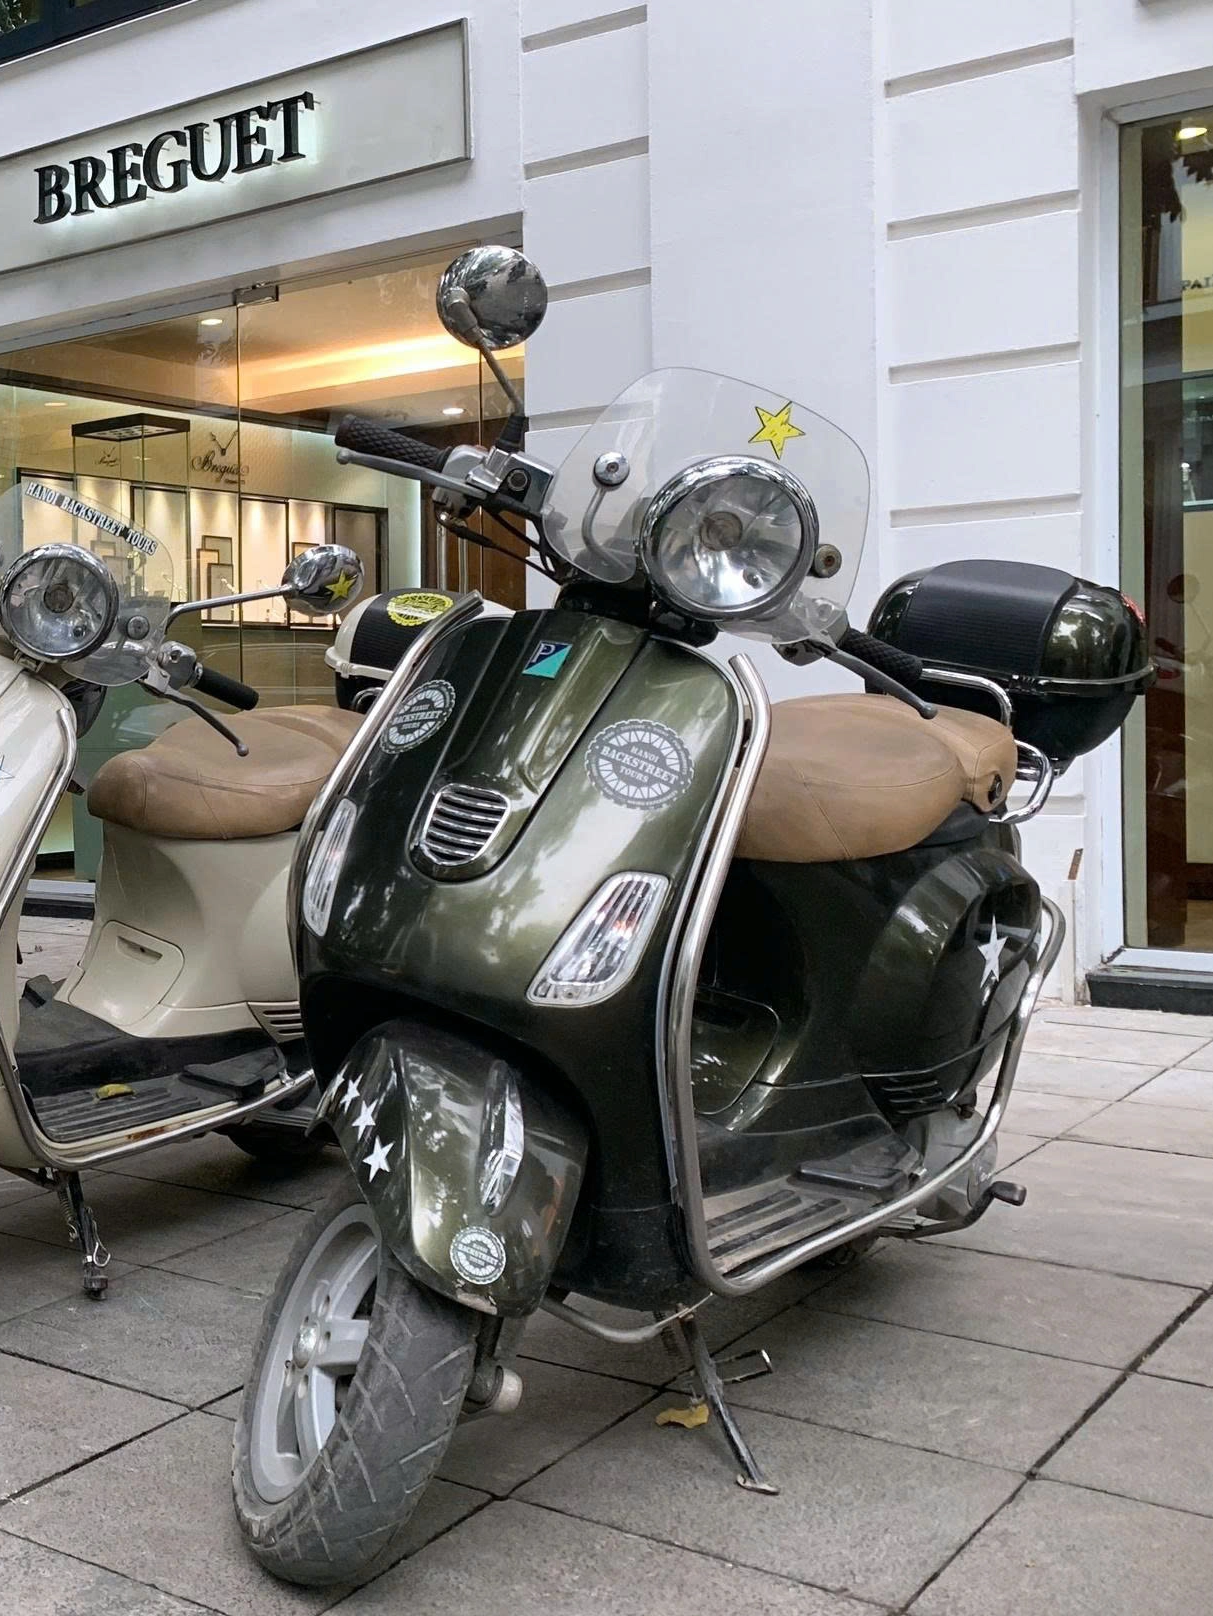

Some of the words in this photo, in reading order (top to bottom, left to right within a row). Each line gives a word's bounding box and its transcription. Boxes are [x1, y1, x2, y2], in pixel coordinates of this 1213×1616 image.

[33, 91, 315, 224] BREGUET
[1180, 274, 1213, 291] PAI
[26, 481, 60, 505] HANOI
[61, 496, 125, 537] BACKSTREET
[126, 529, 158, 555] TOURS
[531, 643, 556, 663] P
[392, 710, 443, 725] BACKSTREET
[630, 746, 660, 763] HANOI
[600, 746, 679, 784] BACKSTREET
[620, 766, 649, 782] TOURS
